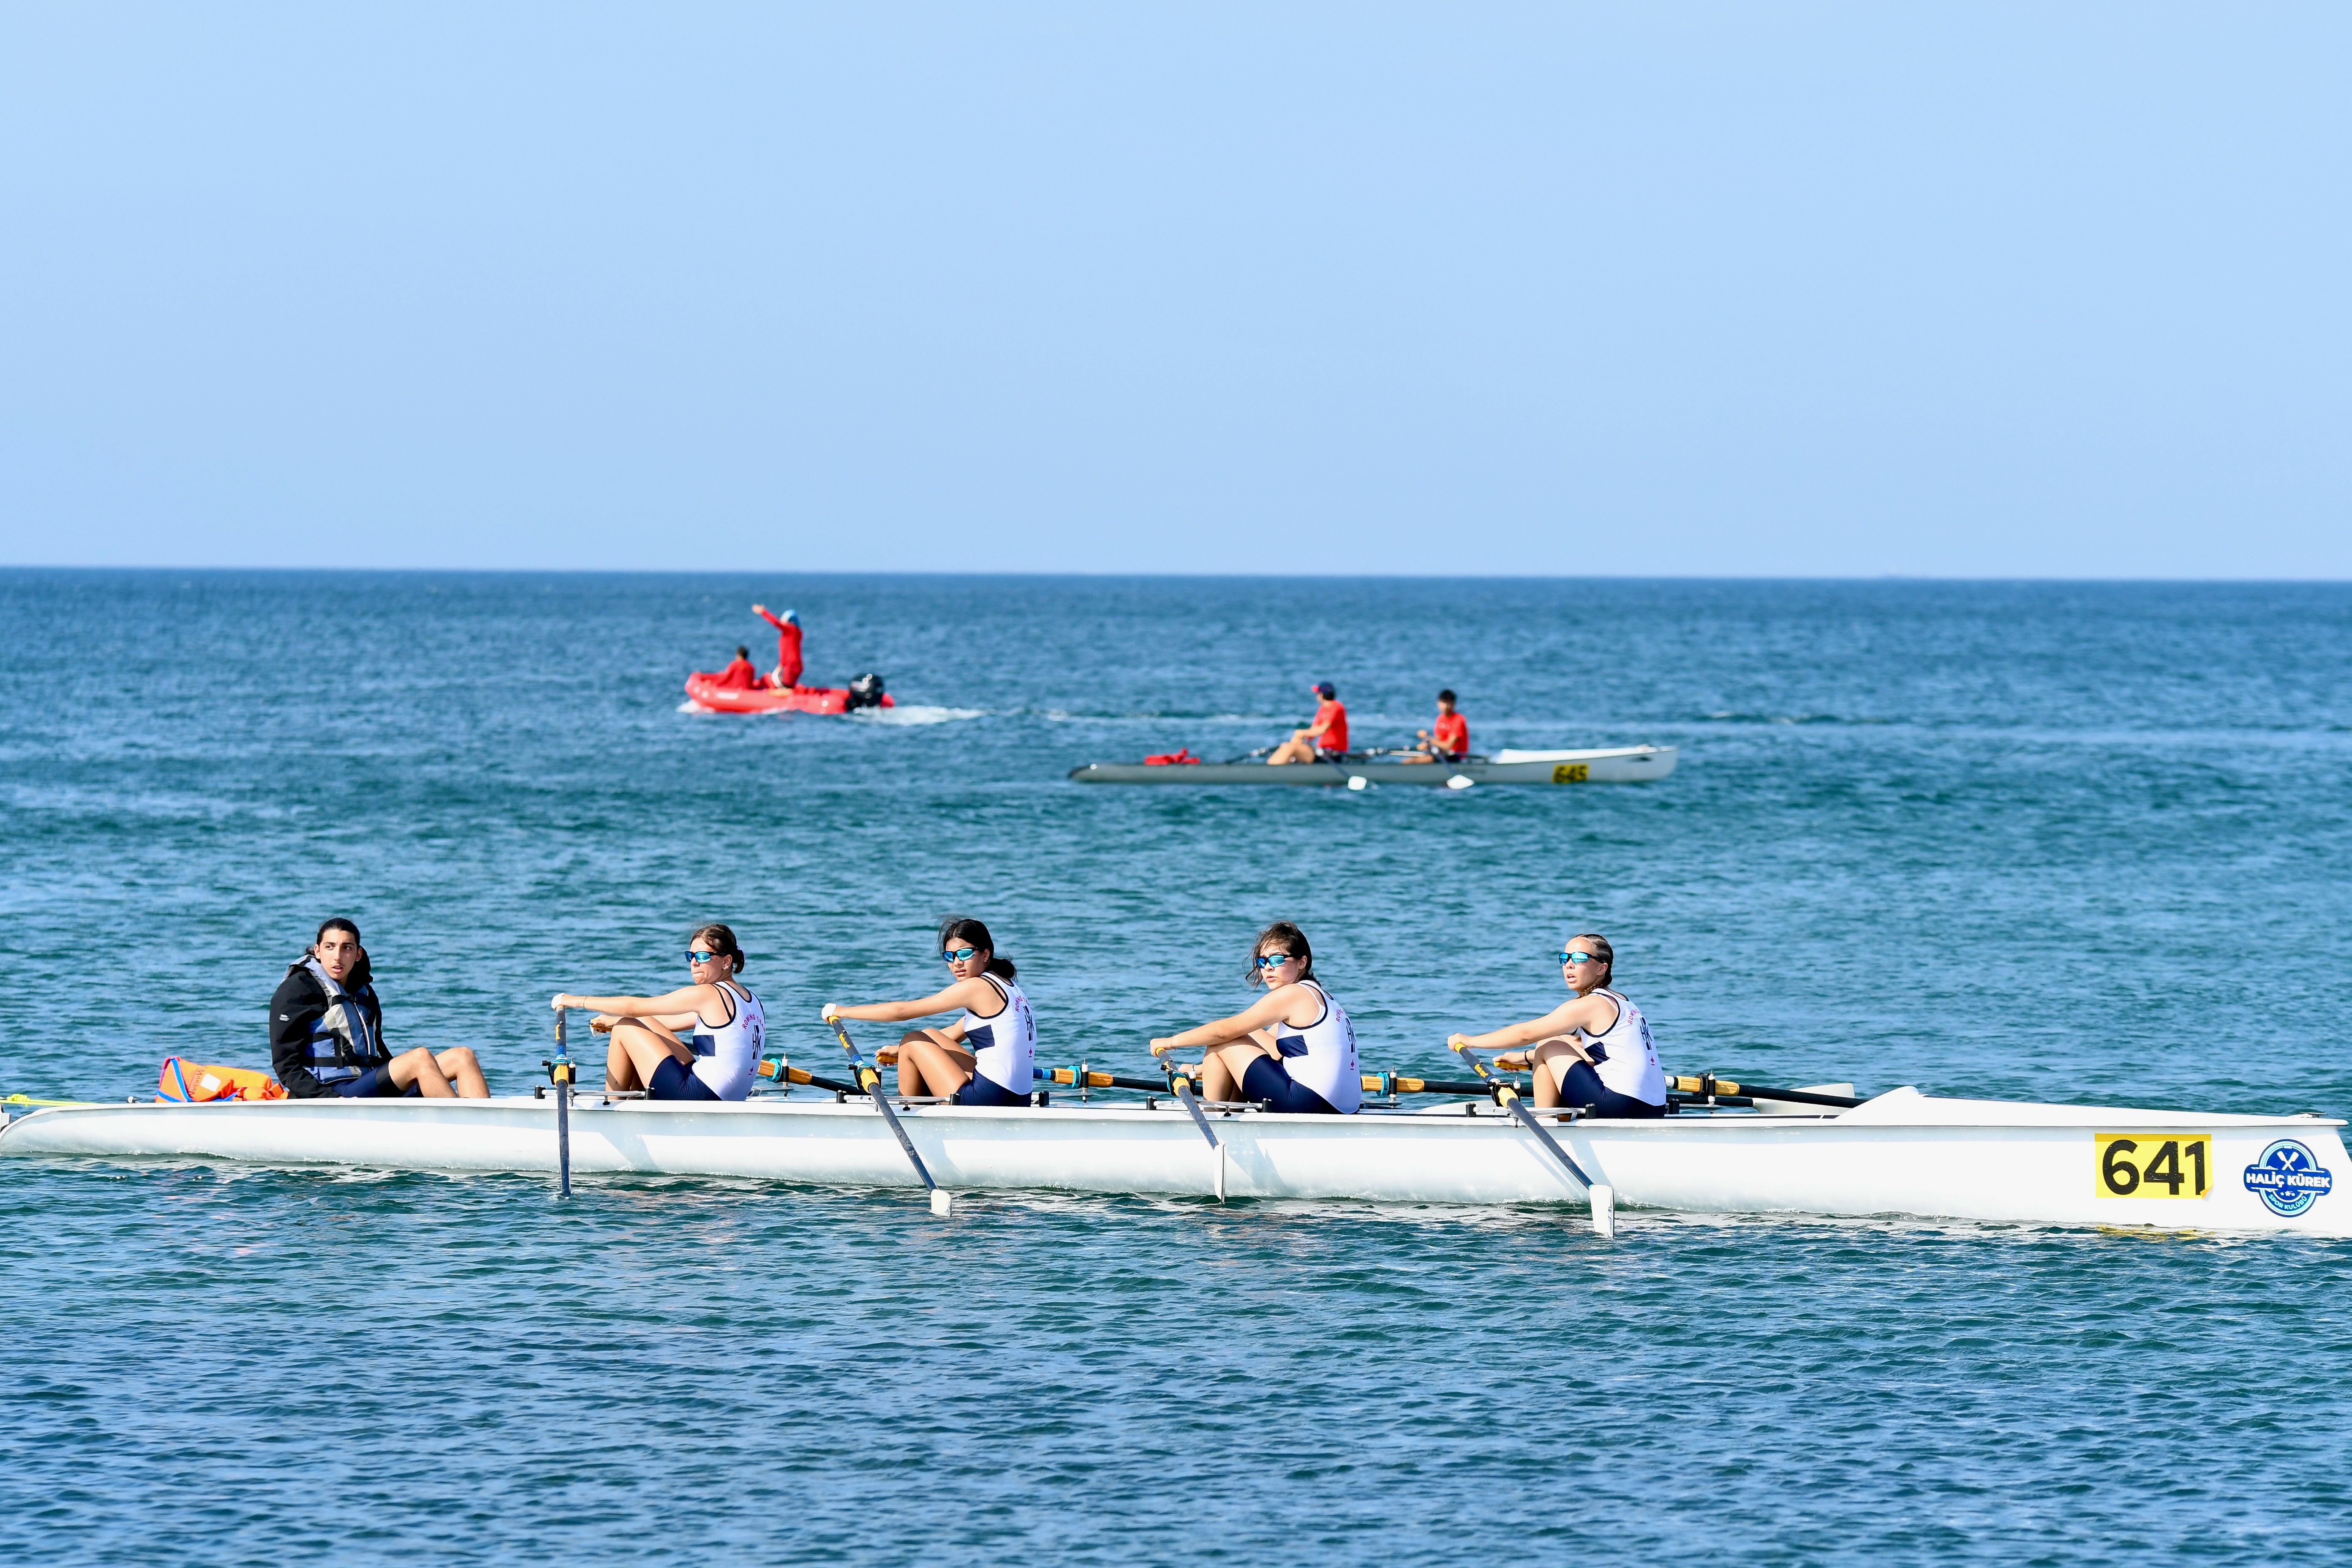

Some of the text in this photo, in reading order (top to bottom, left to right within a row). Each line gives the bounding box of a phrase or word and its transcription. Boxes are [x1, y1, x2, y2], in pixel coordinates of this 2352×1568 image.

[742, 1013, 756, 1030] ROWING
[2102, 1139, 2205, 1195] 641
[2246, 1171, 2330, 1187] HALİÇ KÜREK
[2268, 1194, 2307, 1209] SPOR KULÜBÜ
